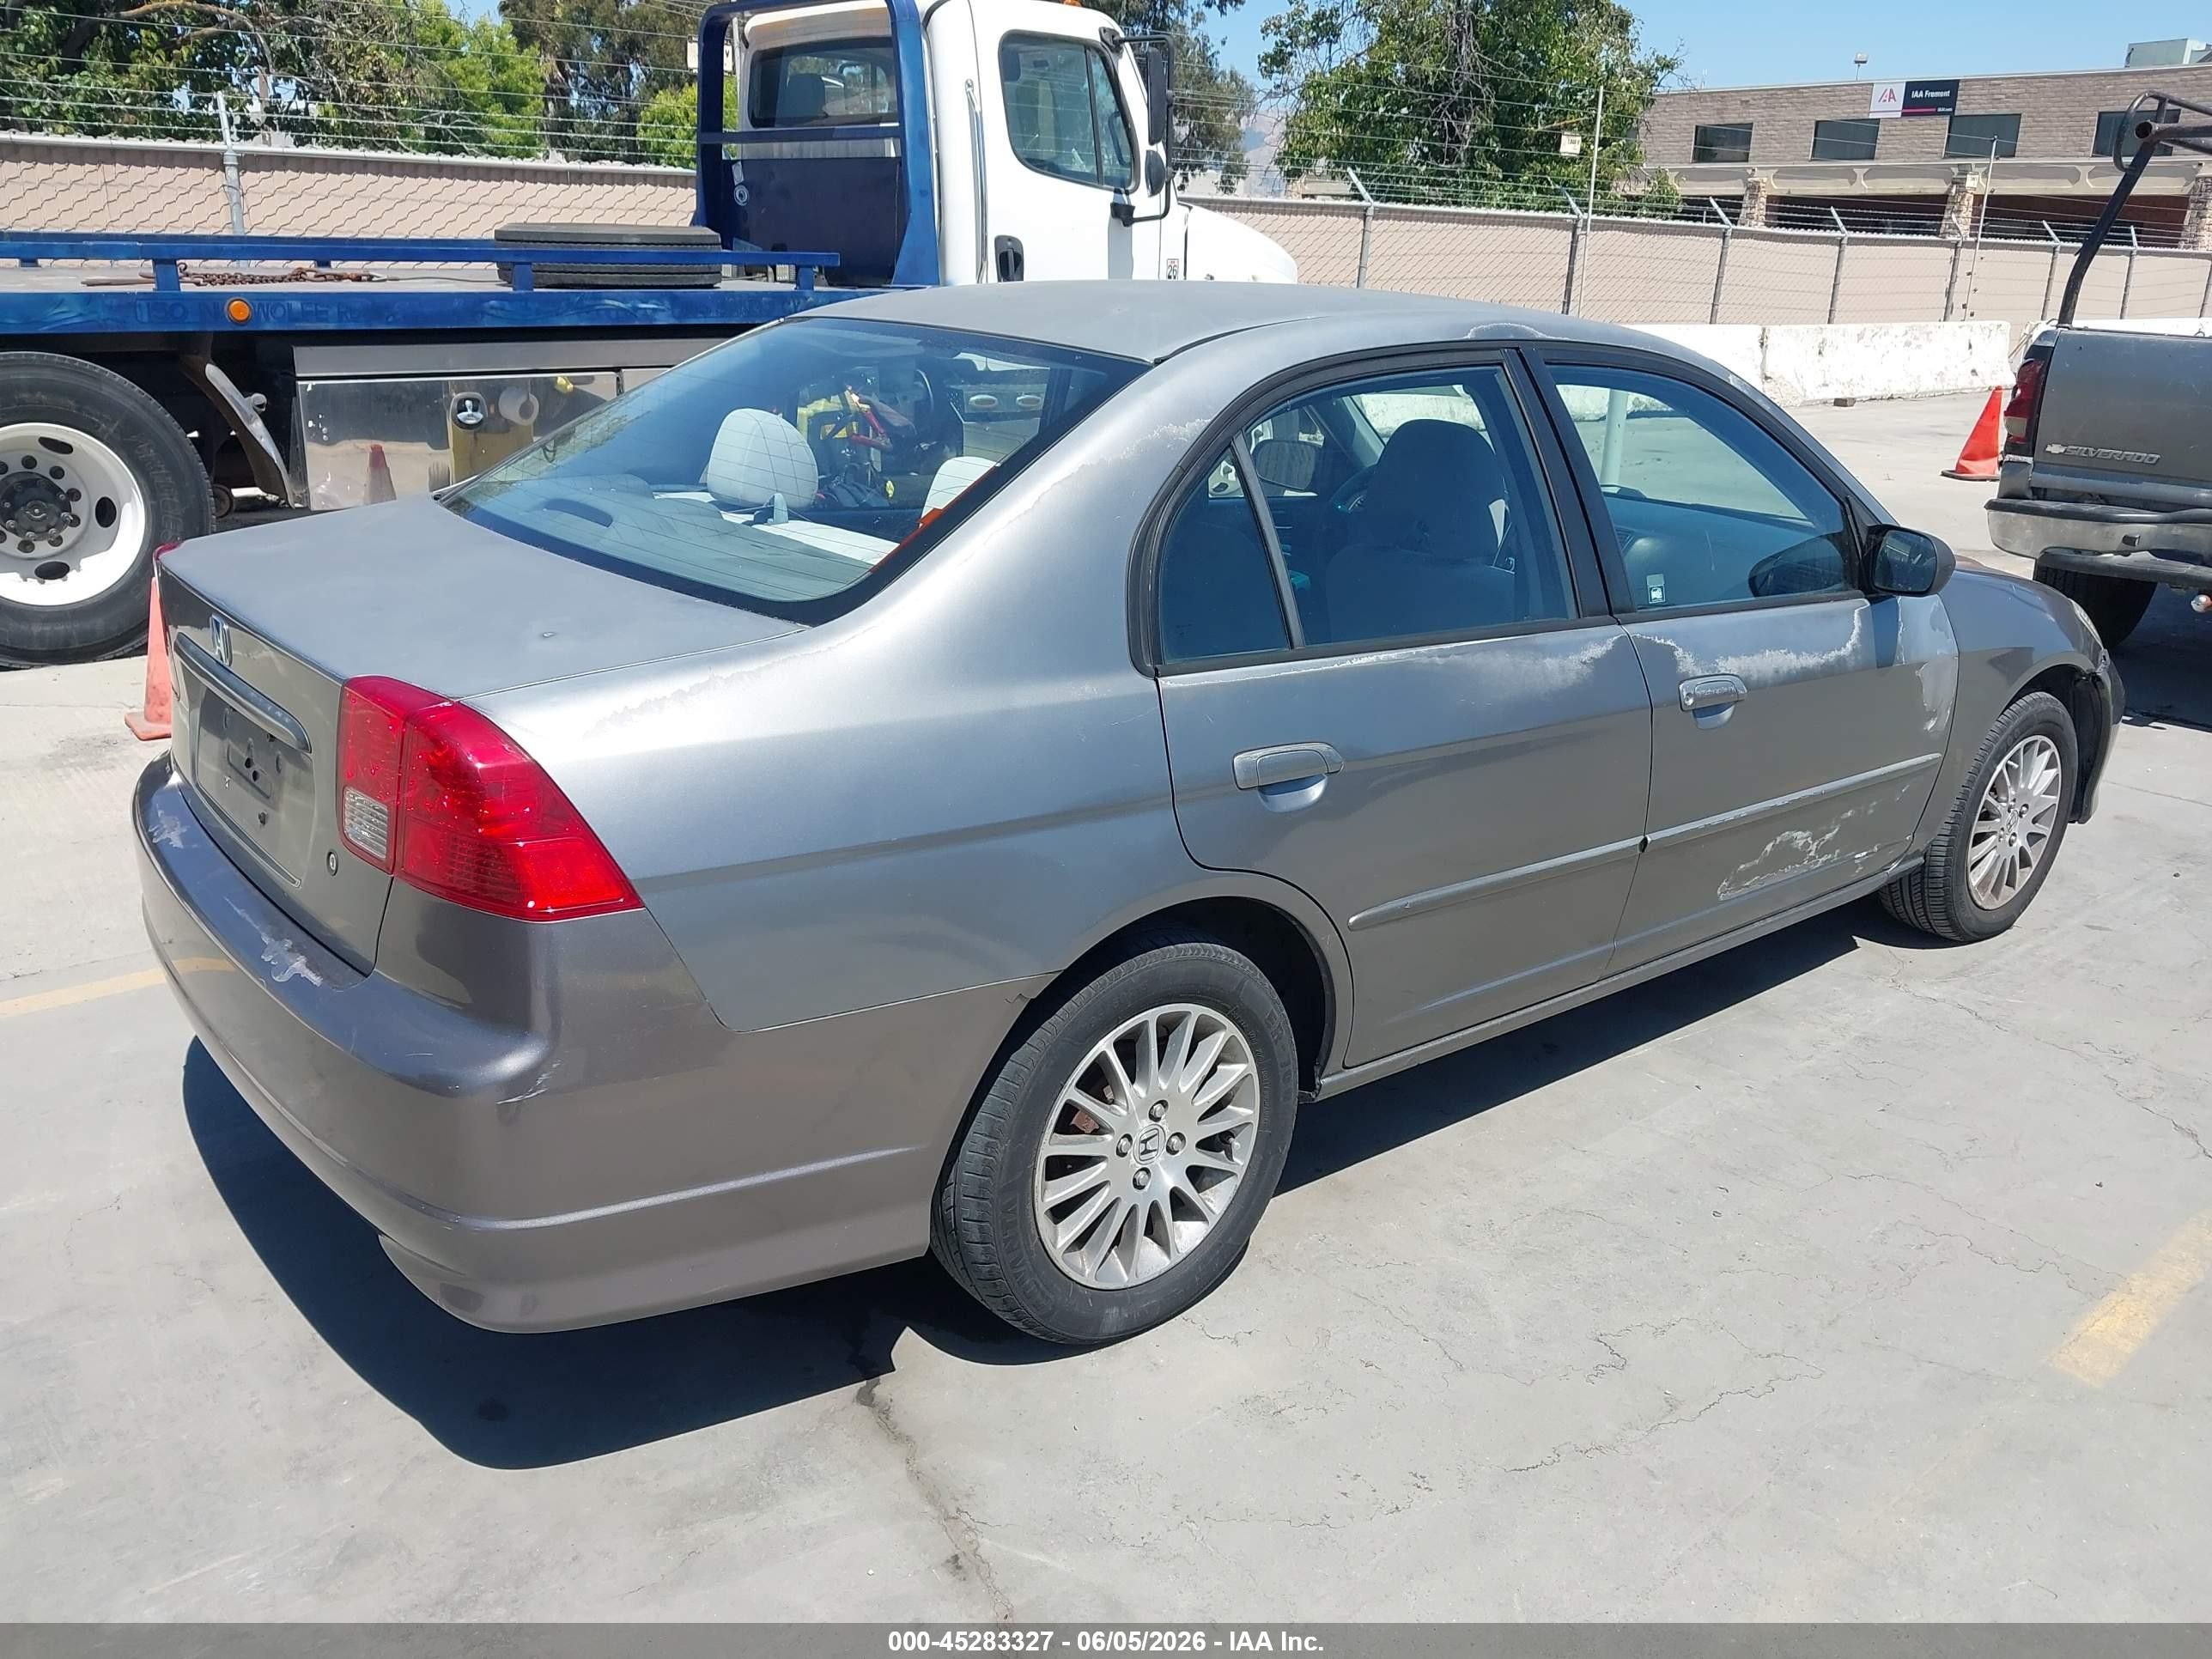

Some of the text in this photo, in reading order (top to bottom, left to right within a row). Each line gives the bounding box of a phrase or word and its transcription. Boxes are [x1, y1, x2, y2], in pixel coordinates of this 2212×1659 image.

[1911, 89, 1950, 99] IAA Fremont
[2063, 445, 2161, 465] SILVERADO
